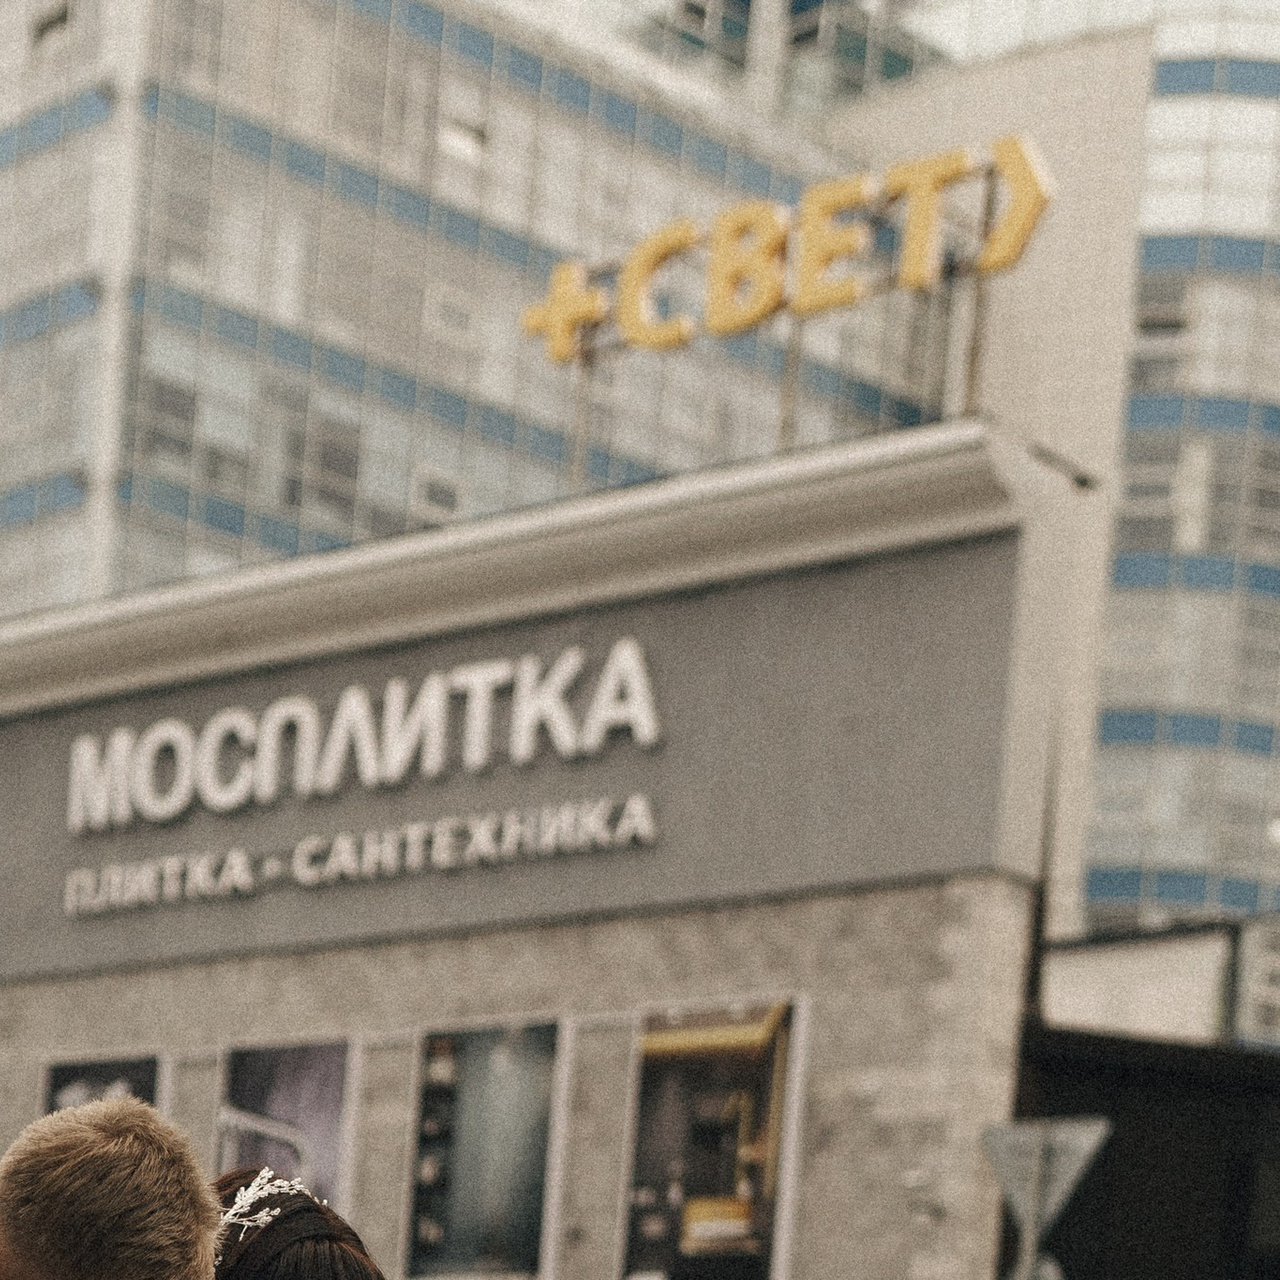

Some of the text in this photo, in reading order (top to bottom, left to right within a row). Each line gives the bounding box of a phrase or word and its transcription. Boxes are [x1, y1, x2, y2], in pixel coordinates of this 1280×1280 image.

[66, 636, 660, 834] МОСПЛИТКА
[64, 795, 657, 914] ПЛИТКА САНТЕХНИКА
